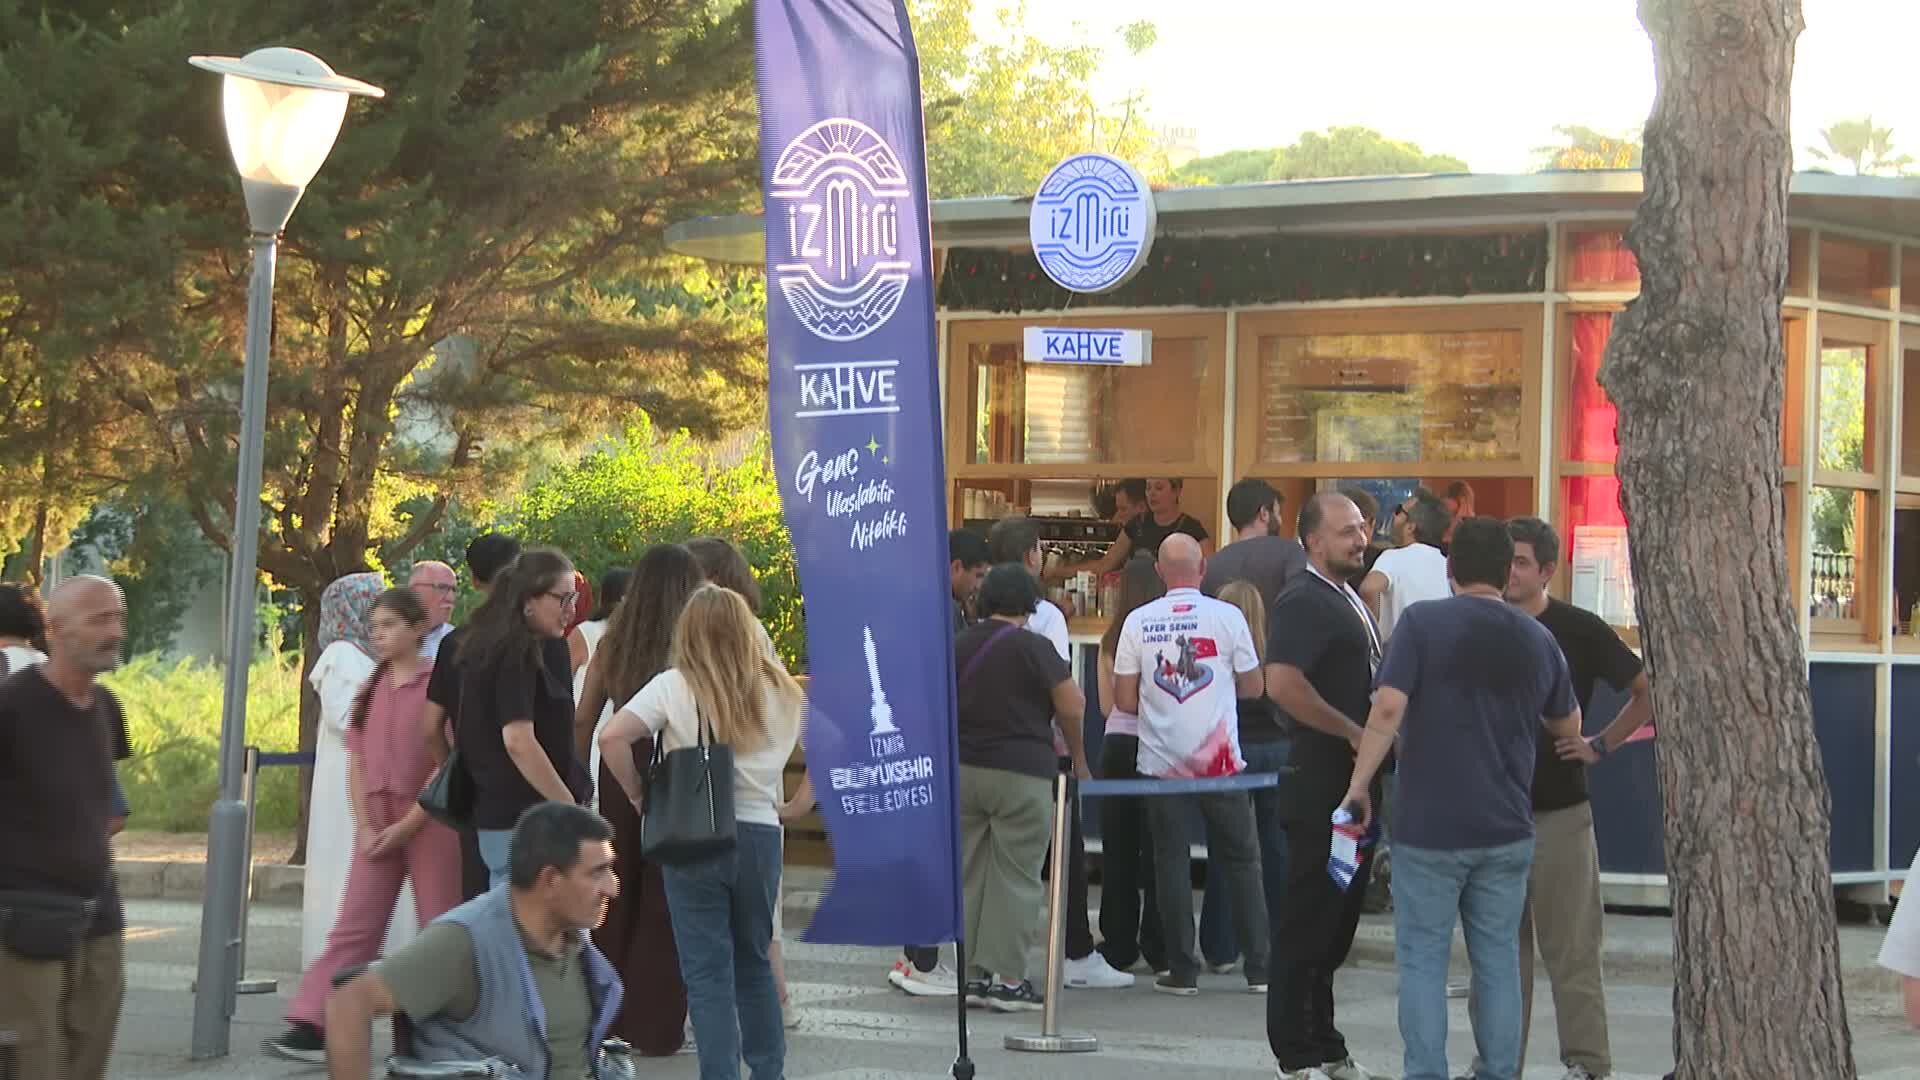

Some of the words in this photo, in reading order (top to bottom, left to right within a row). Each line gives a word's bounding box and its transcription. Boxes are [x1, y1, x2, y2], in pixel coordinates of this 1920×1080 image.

[1046, 332, 1122, 361] KAHVE
[800, 366, 896, 411] KAHVE
[795, 448, 859, 503] Genç
[850, 509, 907, 551] Nitelikli
